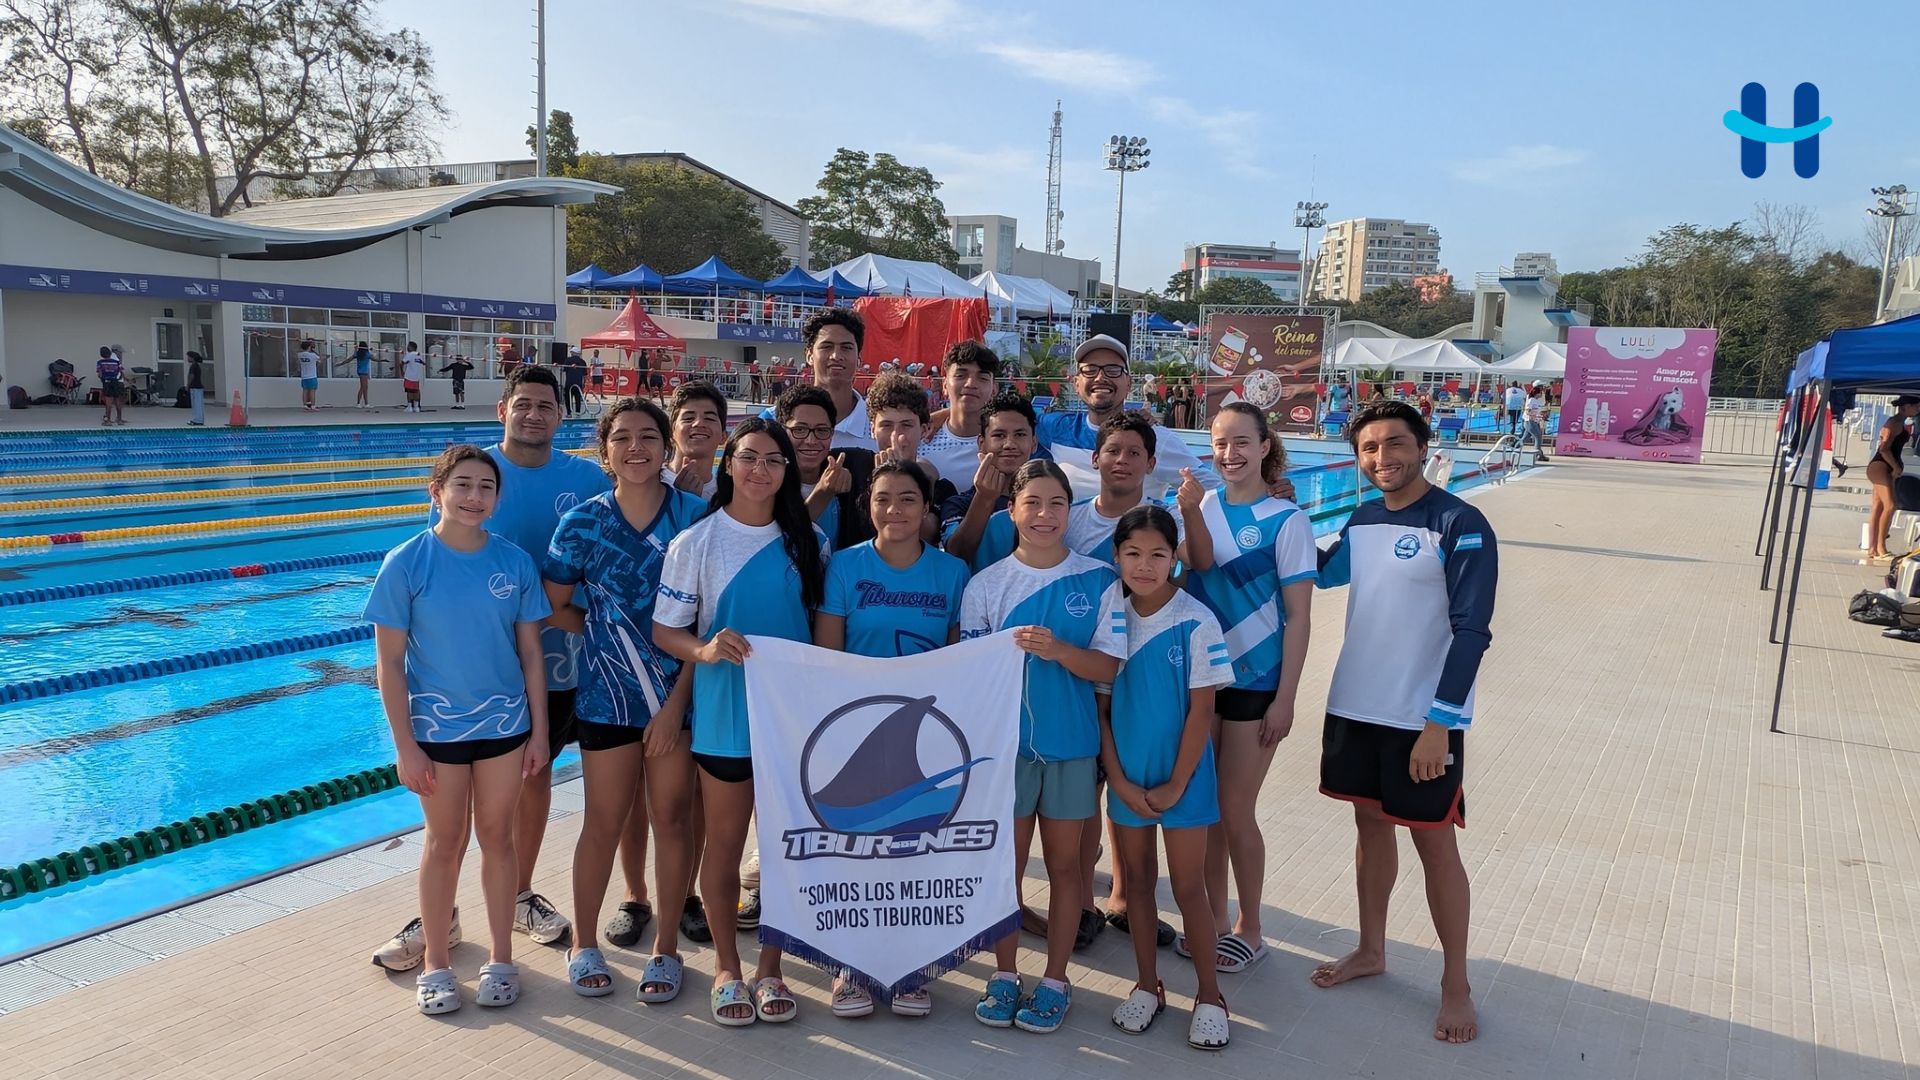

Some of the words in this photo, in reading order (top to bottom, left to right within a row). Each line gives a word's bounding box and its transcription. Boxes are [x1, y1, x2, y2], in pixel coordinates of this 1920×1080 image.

[1272, 324, 1318, 345] Reina
[1620, 334, 1656, 347] LULÚ
[1274, 346, 1289, 356] del
[1289, 345, 1313, 356] sabor
[1656, 367, 1678, 376] Amor
[1679, 369, 1696, 379] por
[1662, 376, 1699, 385] mascota
[855, 579, 948, 610] Tiburones
[782, 820, 998, 860] TIBURONES
[799, 881, 860, 906] “SOMOS
[865, 881, 895, 902] LOS
[900, 876, 983, 901] MEJORES”
[815, 907, 869, 931] SOMOS
[873, 904, 965, 927] TIBURONES
